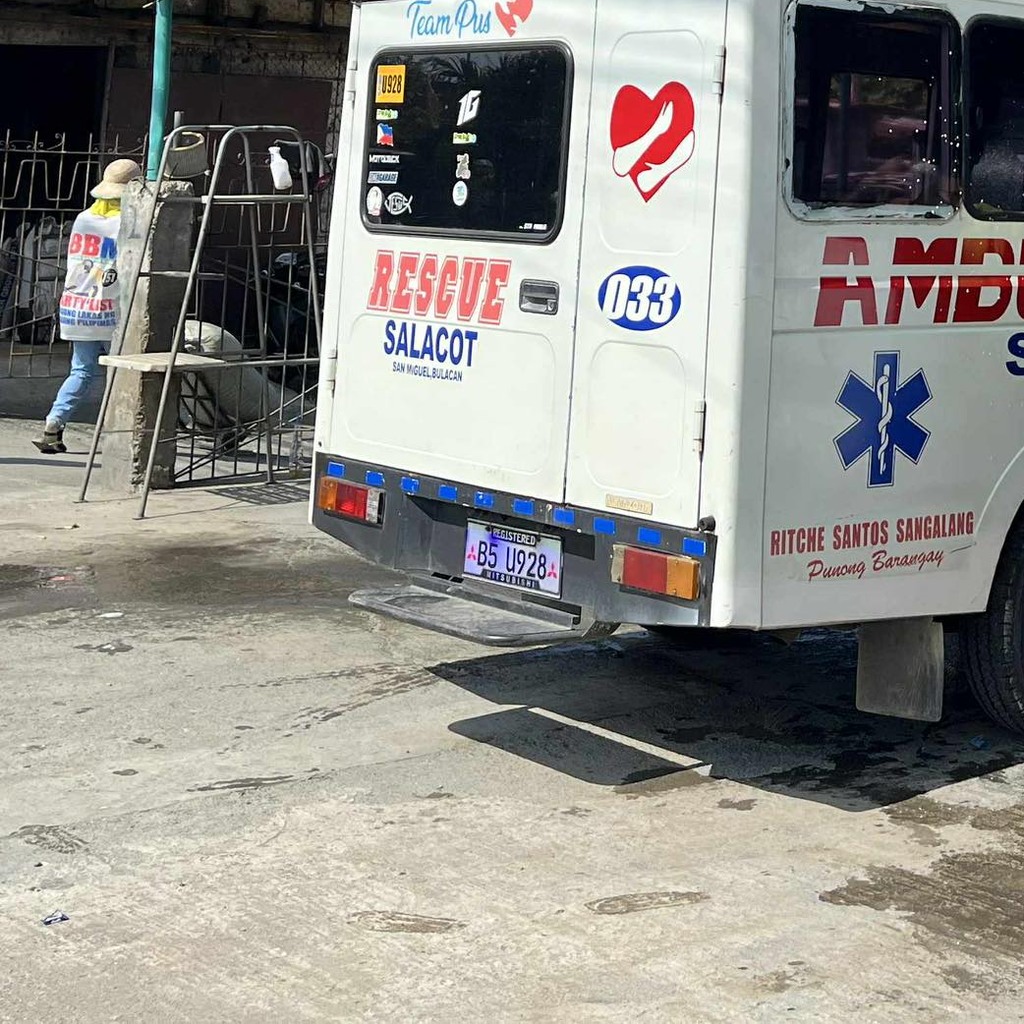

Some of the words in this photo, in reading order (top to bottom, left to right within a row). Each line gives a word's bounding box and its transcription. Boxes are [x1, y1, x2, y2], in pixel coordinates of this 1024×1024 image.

[406, 0, 454, 39] Team
[381, 74, 403, 94] U928
[366, 249, 512, 326] RESCUE
[601, 273, 677, 324] 033
[383, 319, 479, 367] SALACOT
[392, 361, 406, 373] SAN
[491, 528, 537, 546] REGISTERED
[770, 527, 826, 557] RITCHE
[832, 519, 889, 550] SANTOS
[896, 510, 975, 543] SANGALANG
[476, 539, 499, 569] B5
[505, 545, 548, 581] U928
[485, 569, 536, 589] MITSUBISHI
[806, 559, 867, 583] Punong
[871, 549, 944, 571] Barangay
